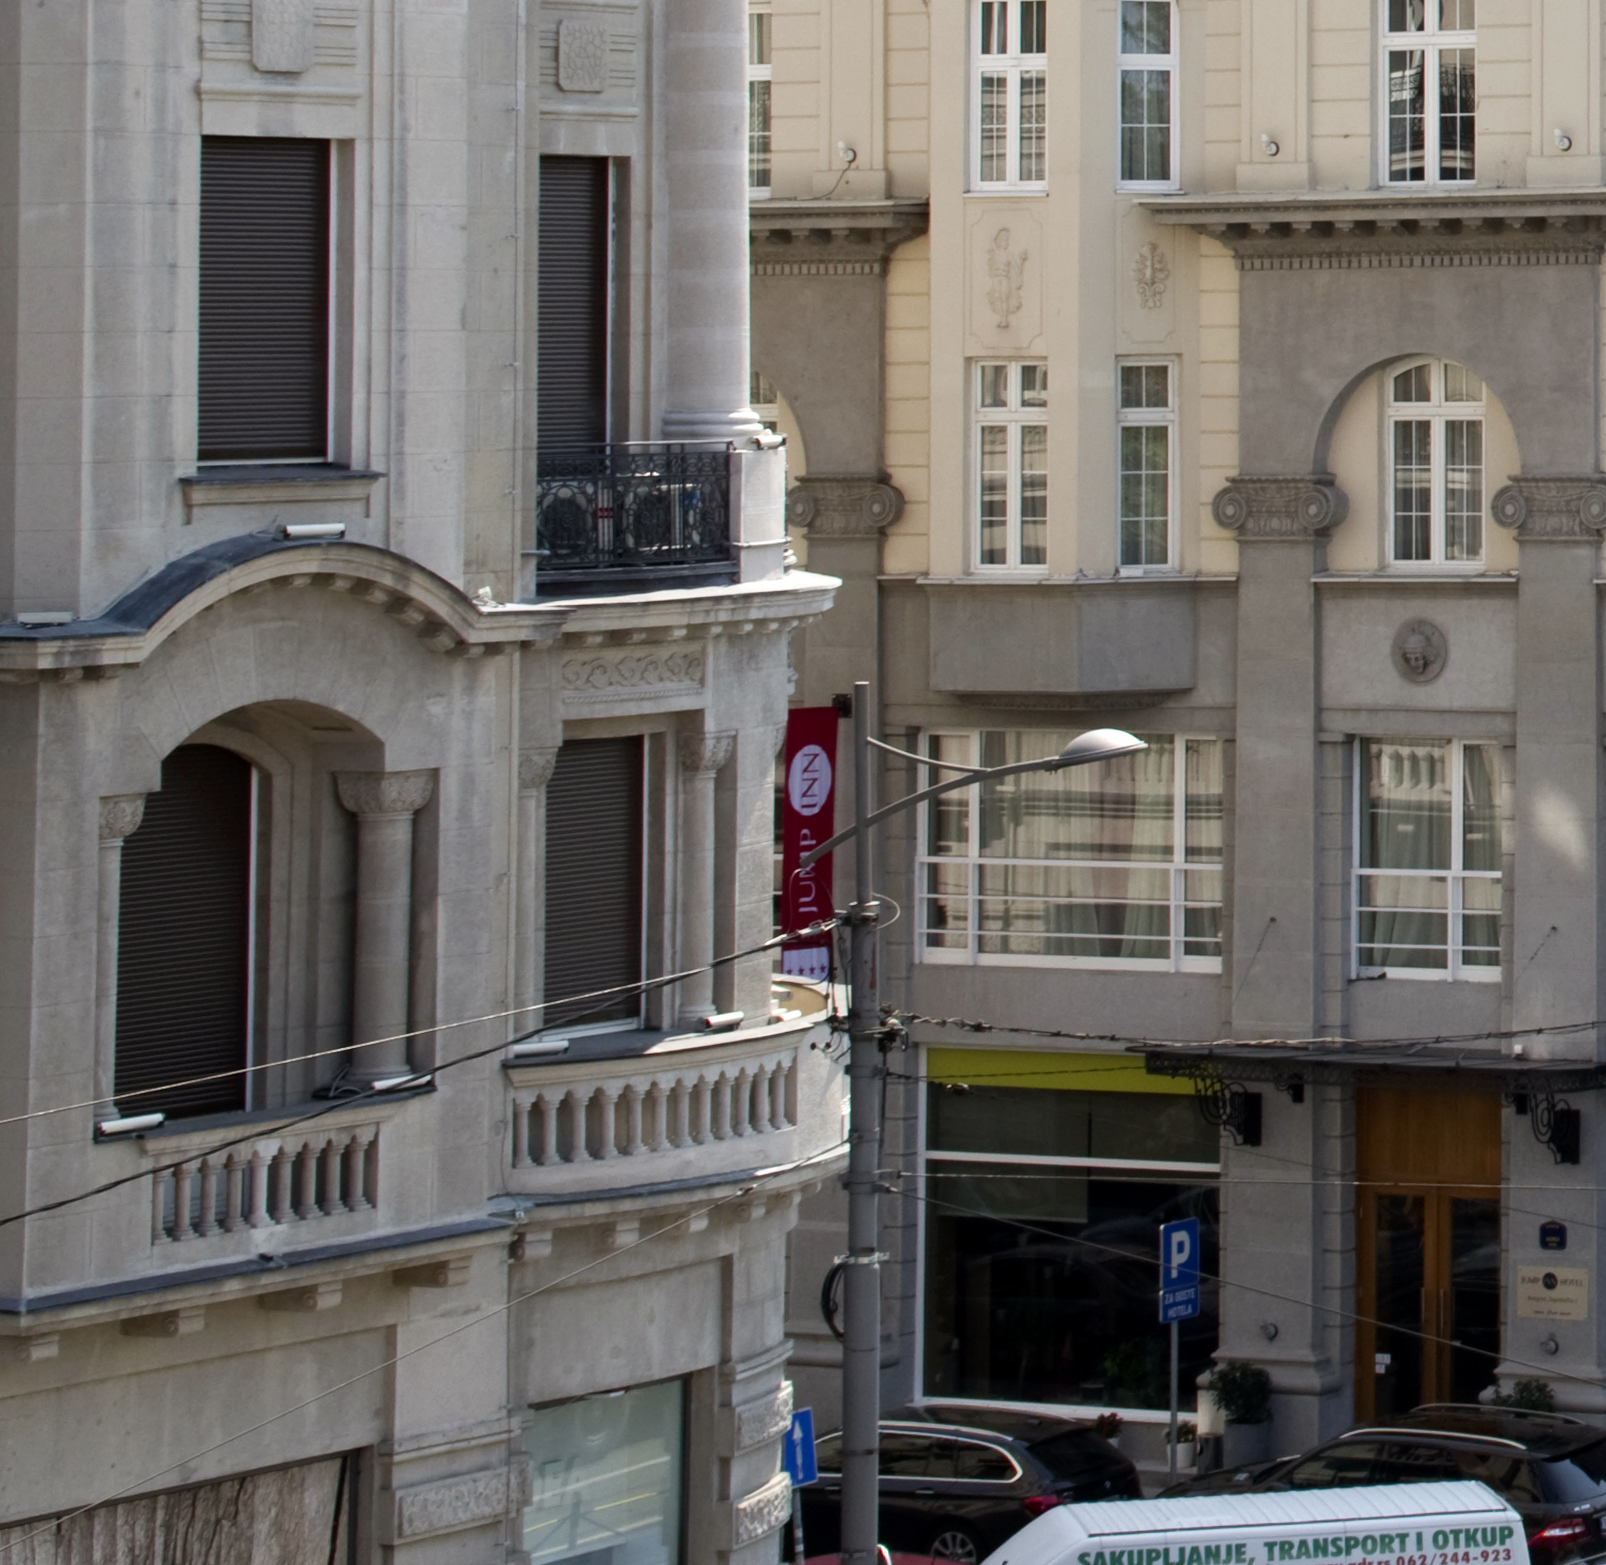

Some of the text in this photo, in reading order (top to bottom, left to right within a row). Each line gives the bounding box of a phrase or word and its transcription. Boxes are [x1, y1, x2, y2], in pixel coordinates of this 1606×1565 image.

[801, 753, 819, 809] INN
[1171, 1230, 1191, 1279] P
[1077, 1525, 1514, 1565] SAKUPLJANJE, TRANSPORT I OTKUP
[1396, 1548, 1512, 1565] 062/244-923
